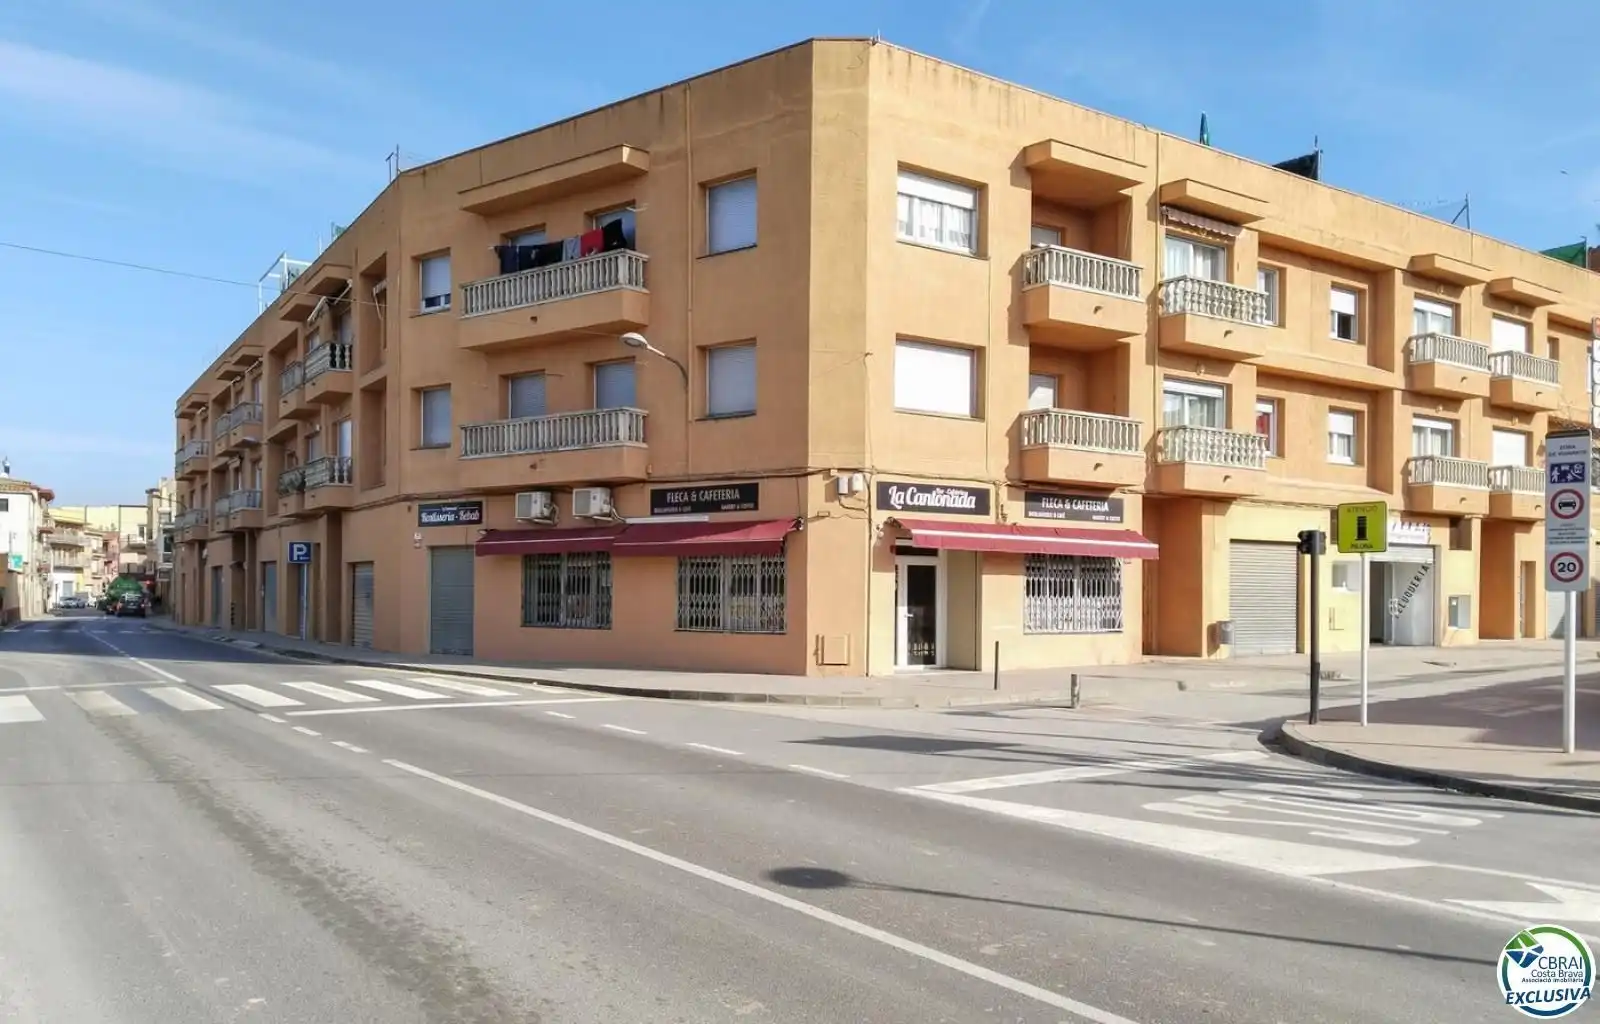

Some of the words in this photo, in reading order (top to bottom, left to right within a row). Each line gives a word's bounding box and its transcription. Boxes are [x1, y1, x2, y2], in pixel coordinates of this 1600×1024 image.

[667, 491, 689, 503] FLECA
[690, 490, 697, 501] &
[699, 488, 740, 502] CAFETERIA
[888, 485, 905, 510] La
[905, 486, 977, 509] Cantonada
[1041, 497, 1063, 509] FLECA
[1064, 498, 1071, 509] &
[1072, 499, 1109, 512] CAFETERIA
[293, 543, 307, 560] P
[1557, 562, 1577, 573] 20
